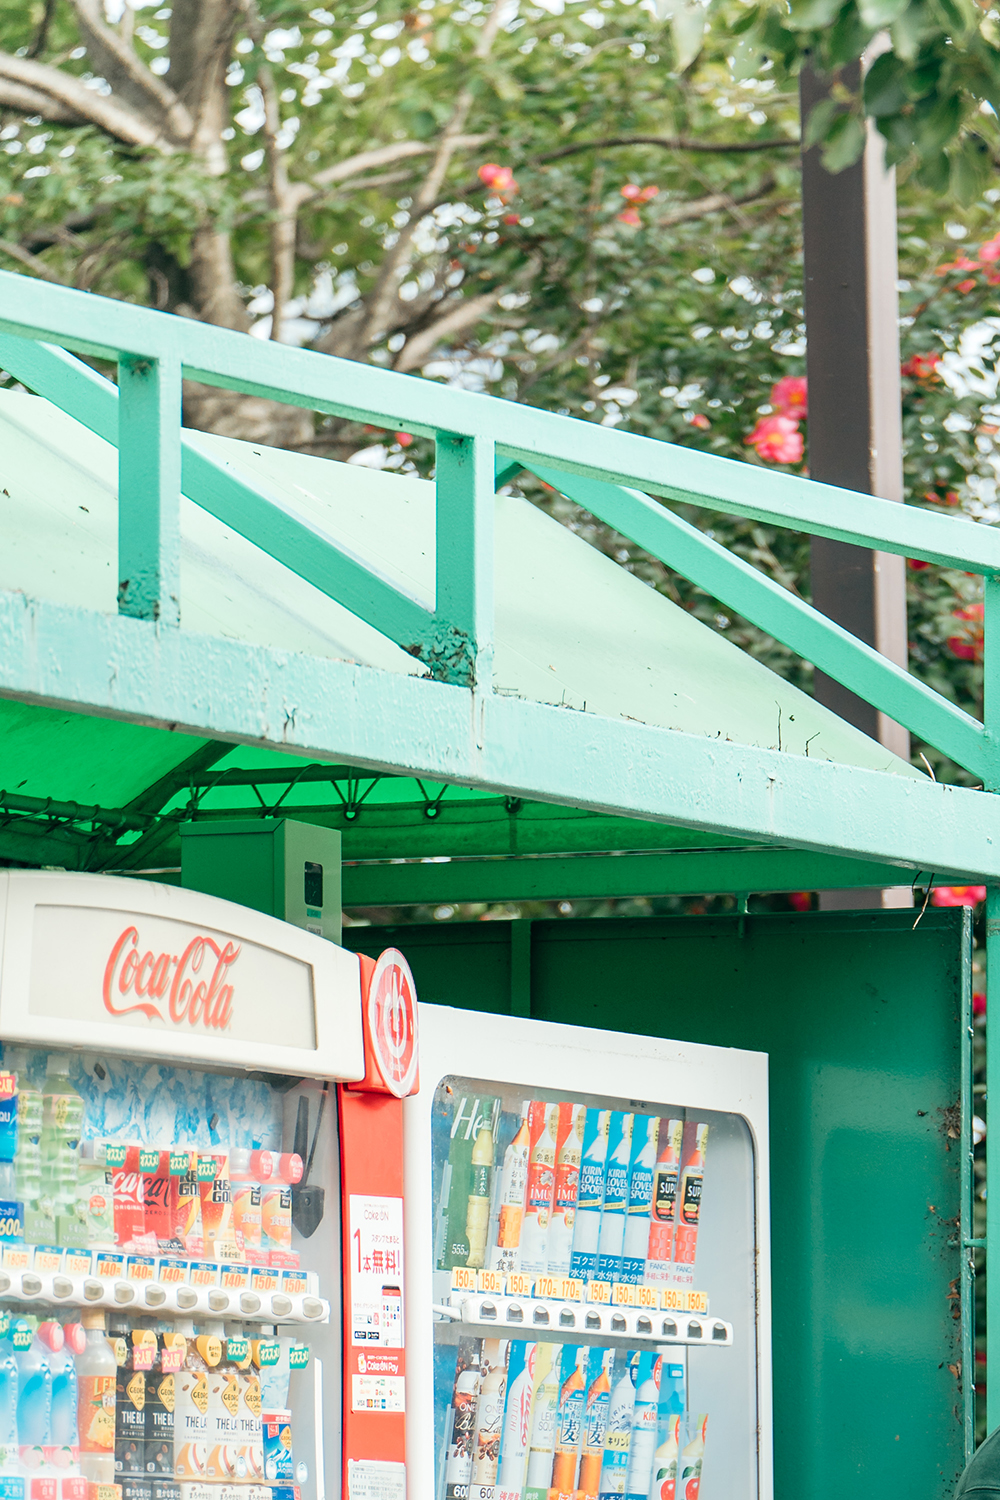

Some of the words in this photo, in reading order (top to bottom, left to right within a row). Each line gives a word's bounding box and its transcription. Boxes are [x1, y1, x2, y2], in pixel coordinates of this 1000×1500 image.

[103, 925, 241, 1030] Coca-Cola
[456, 1270, 475, 1289] 150円
[482, 1272, 500, 1291] 150円
[510, 1275, 528, 1294] 150円
[539, 1278, 557, 1297] 170円
[562, 1280, 580, 1299] 170円
[591, 1283, 608, 1300] 150円
[616, 1286, 633, 1303] 150円
[639, 1288, 656, 1305] 150円
[664, 1291, 682, 1308] 150円
[687, 1293, 705, 1310] 150円
[121, 1410, 136, 1424] THE
[152, 1412, 167, 1426] THE
[185, 1415, 199, 1428] THE
[215, 1417, 230, 1430] THE
[240, 1419, 255, 1431] THE
